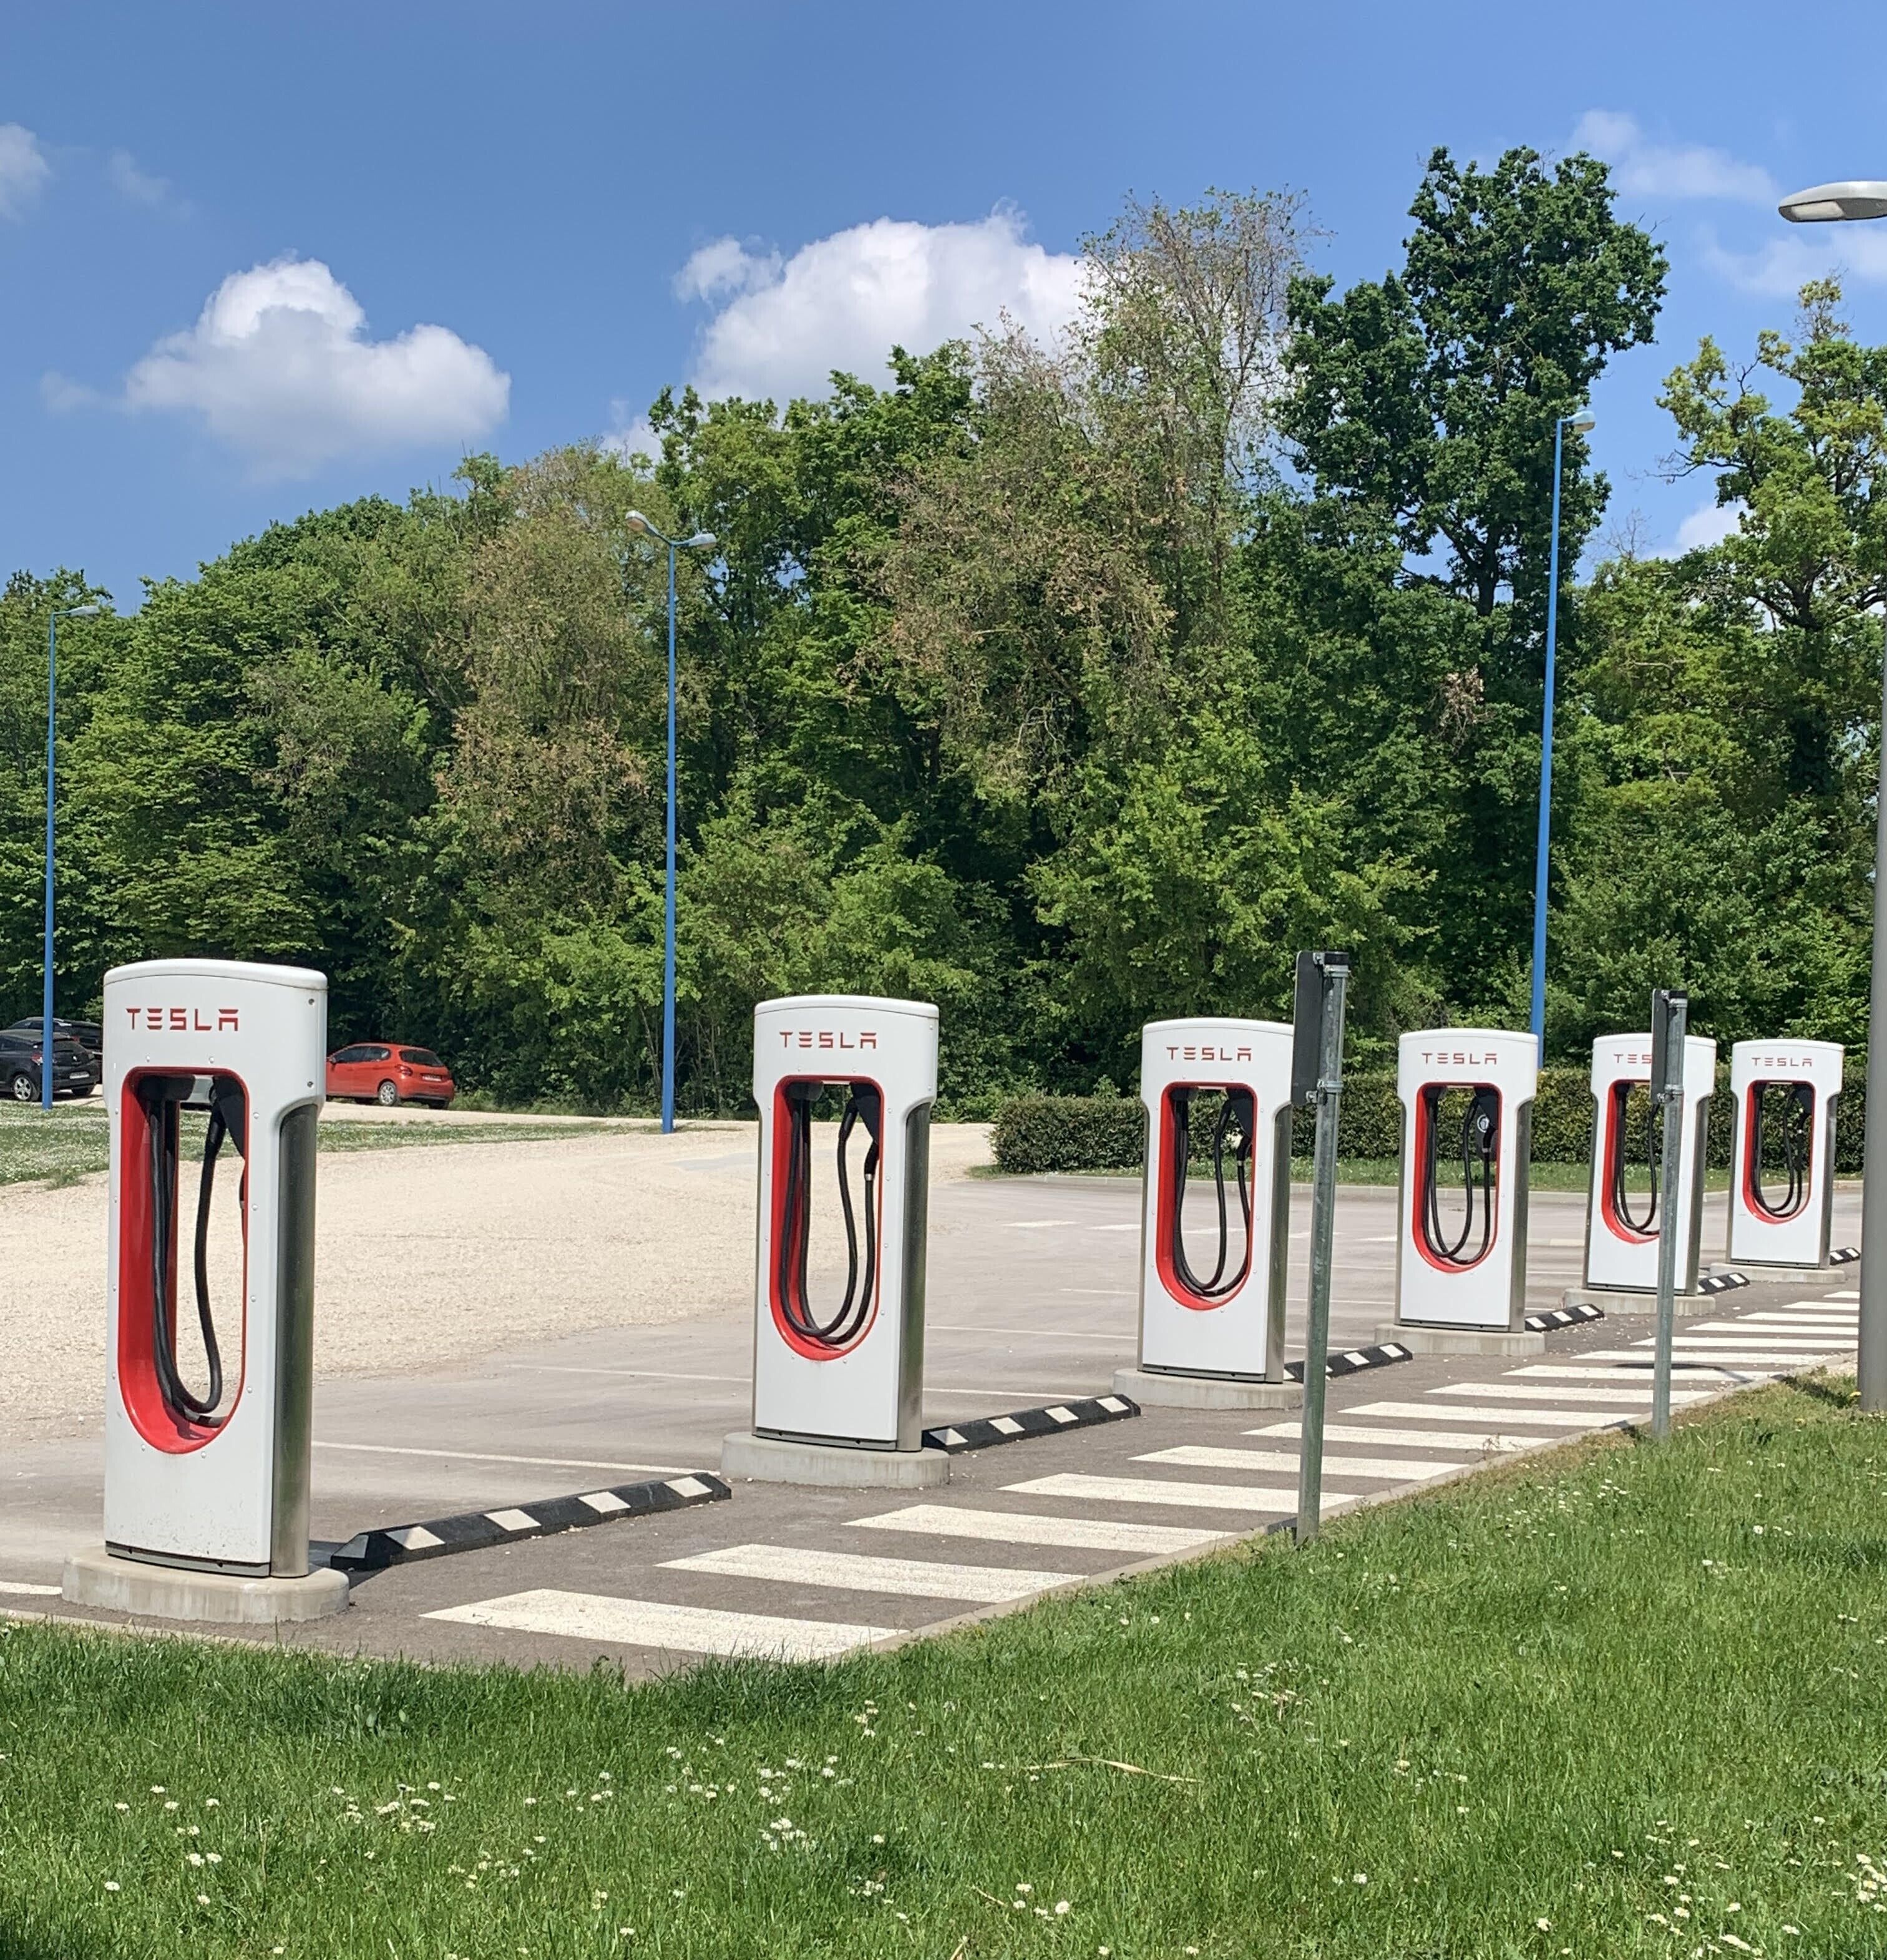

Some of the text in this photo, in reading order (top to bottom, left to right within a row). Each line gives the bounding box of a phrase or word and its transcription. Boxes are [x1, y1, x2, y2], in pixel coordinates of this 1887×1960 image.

[126, 1008, 238, 1031] TESLA
[779, 1031, 877, 1049] TESLA
[1167, 1046, 1252, 1061] TESLA
[1421, 1053, 1497, 1065] TESLA
[1614, 1054, 1652, 1064] TES
[1752, 1057, 1812, 1067] TESLA
